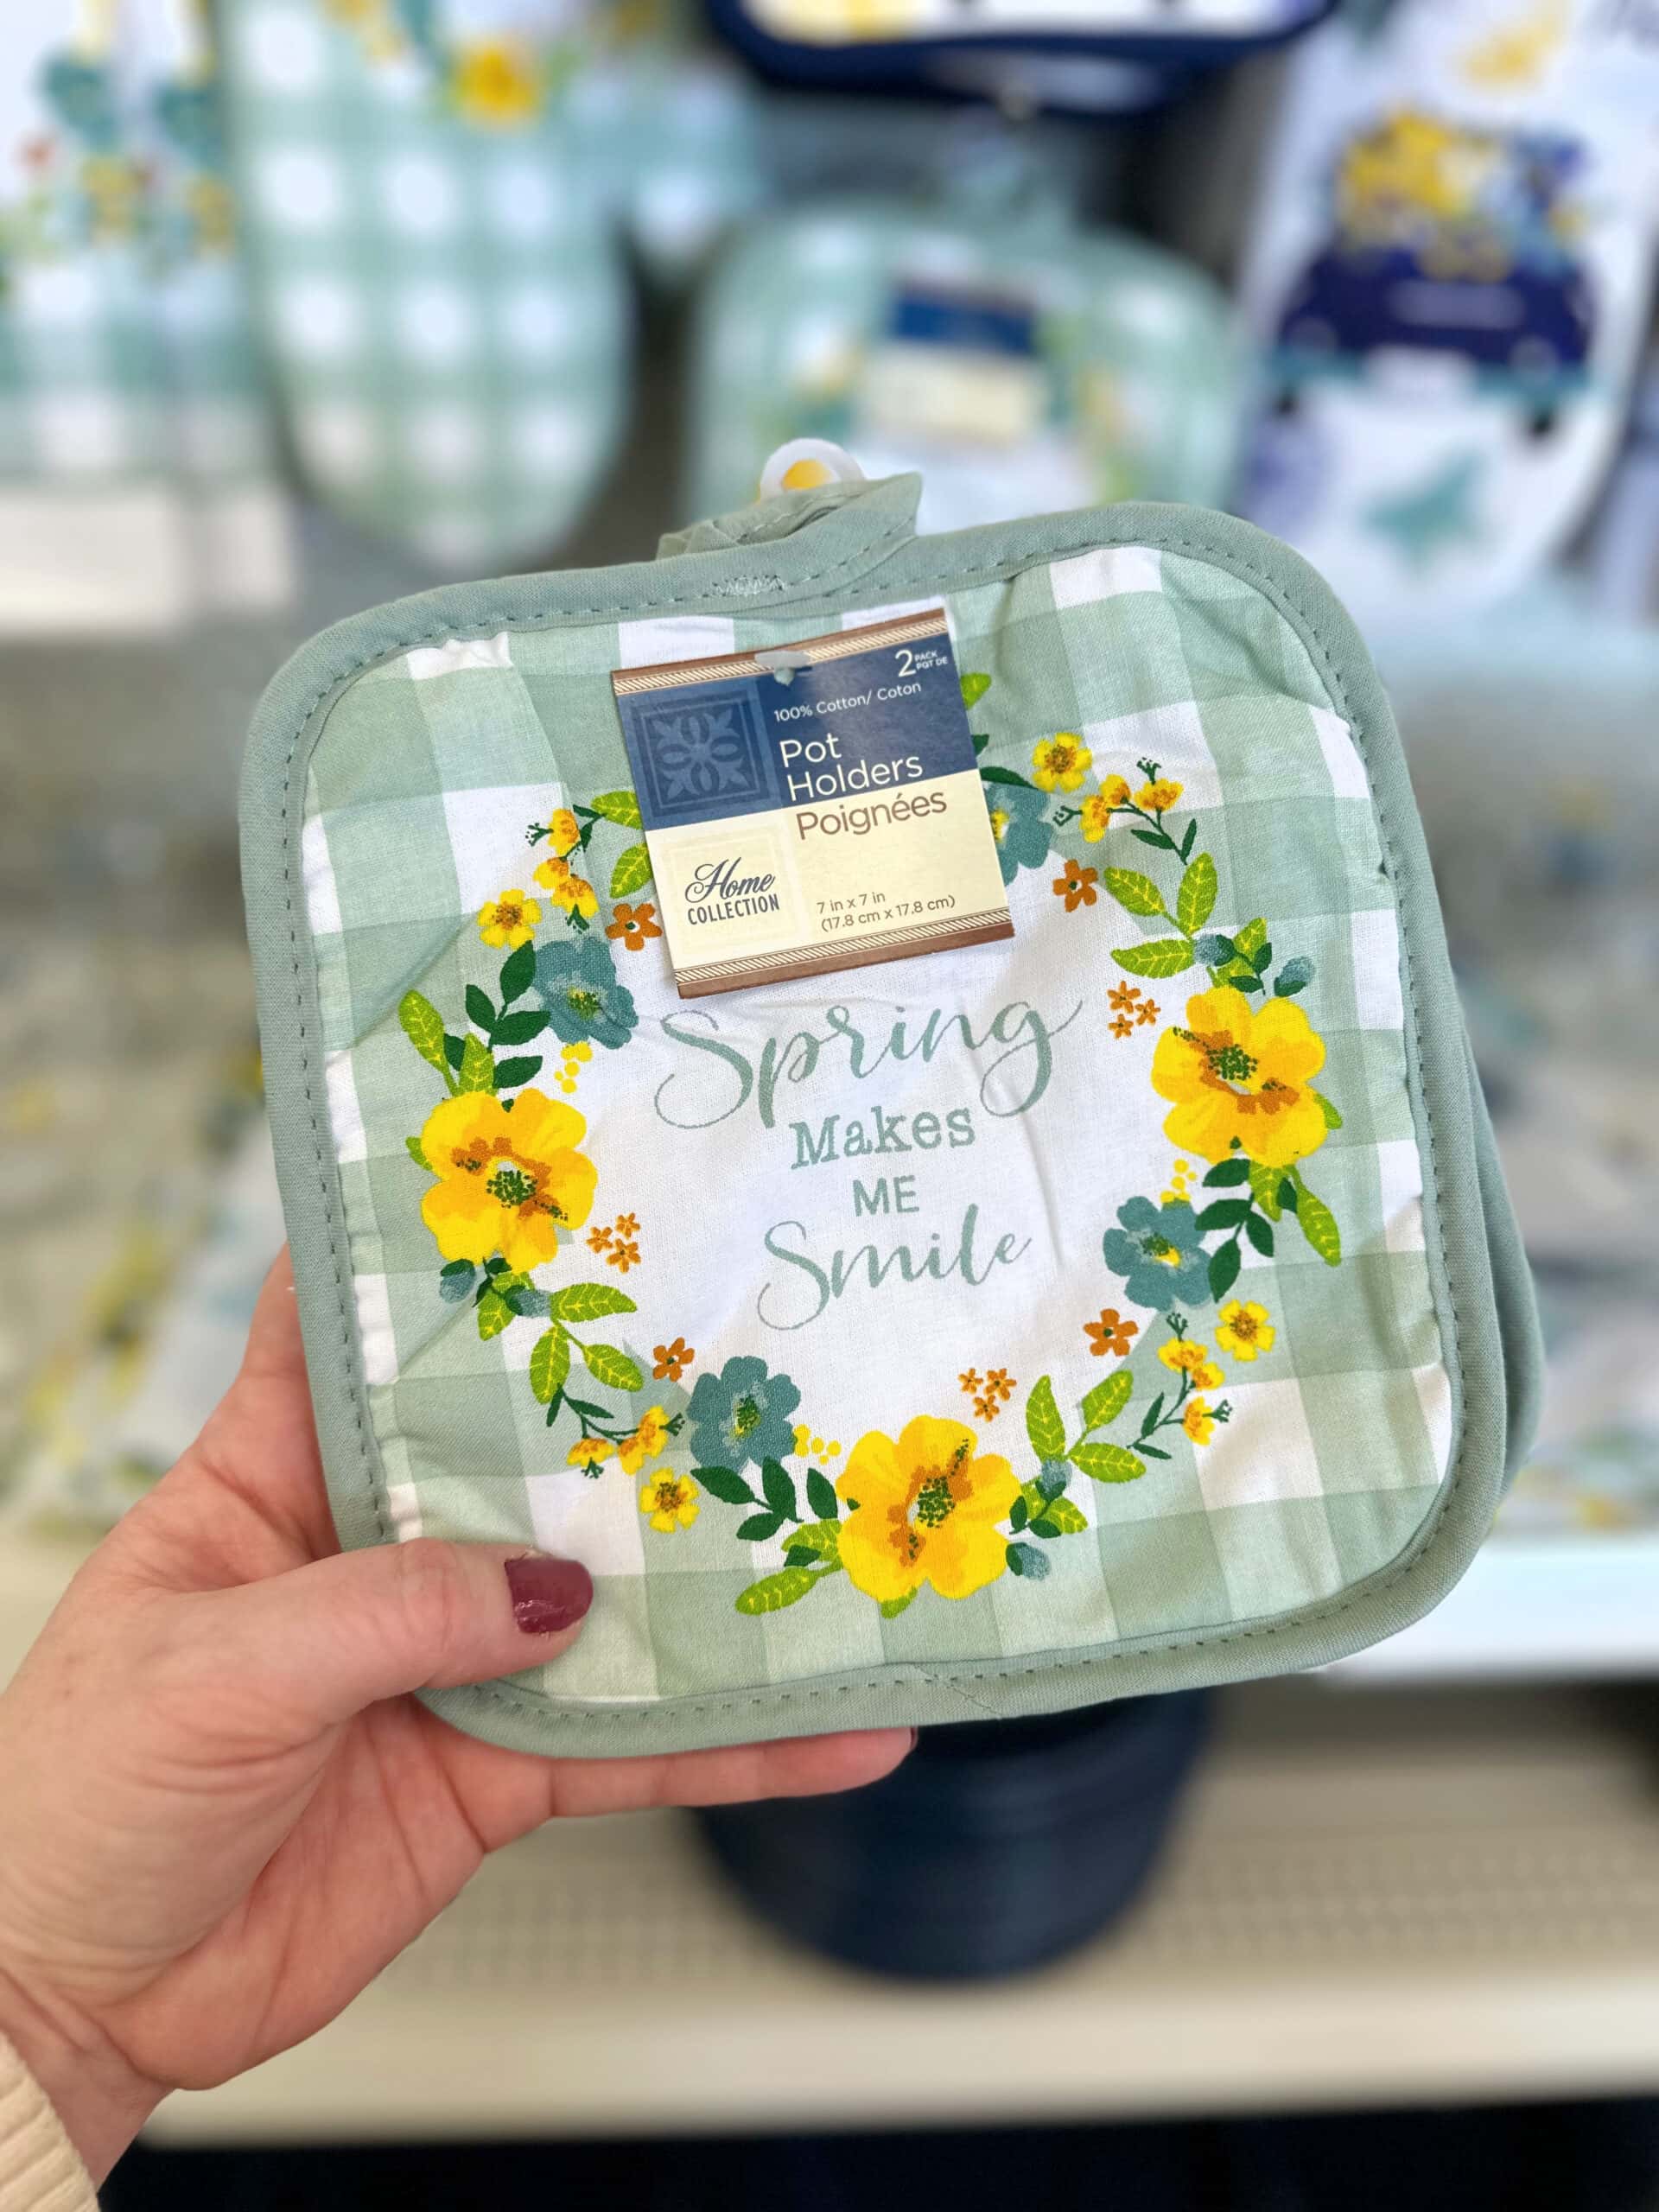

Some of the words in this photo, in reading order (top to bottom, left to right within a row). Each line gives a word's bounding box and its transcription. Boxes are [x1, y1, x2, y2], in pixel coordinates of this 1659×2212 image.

[895, 649, 916, 677] 2
[914, 650, 938, 662] PACK
[935, 656, 948, 666] DE
[773, 705, 813, 722] 100%
[816, 690, 873, 715] Cotton/
[877, 682, 922, 701] Coton
[779, 732, 842, 768] Pot
[786, 755, 924, 802] Holders
[796, 791, 948, 841] Poignées
[684, 856, 776, 904] Home
[687, 893, 780, 925] COLLECTION
[817, 901, 825, 914] 7
[830, 899, 844, 912] in
[846, 898, 856, 908] x
[858, 893, 868, 906] 7
[871, 891, 886, 904] in
[821, 913, 855, 932] (17.8
[857, 911, 881, 925] cm
[884, 908, 893, 919] x
[895, 900, 924, 917] 17.8
[926, 894, 957, 912] cm)
[654, 1000, 1084, 1129] Spring
[790, 1105, 976, 1169] Makes
[851, 1174, 920, 1217] ME
[757, 1203, 1033, 1332] Smile
